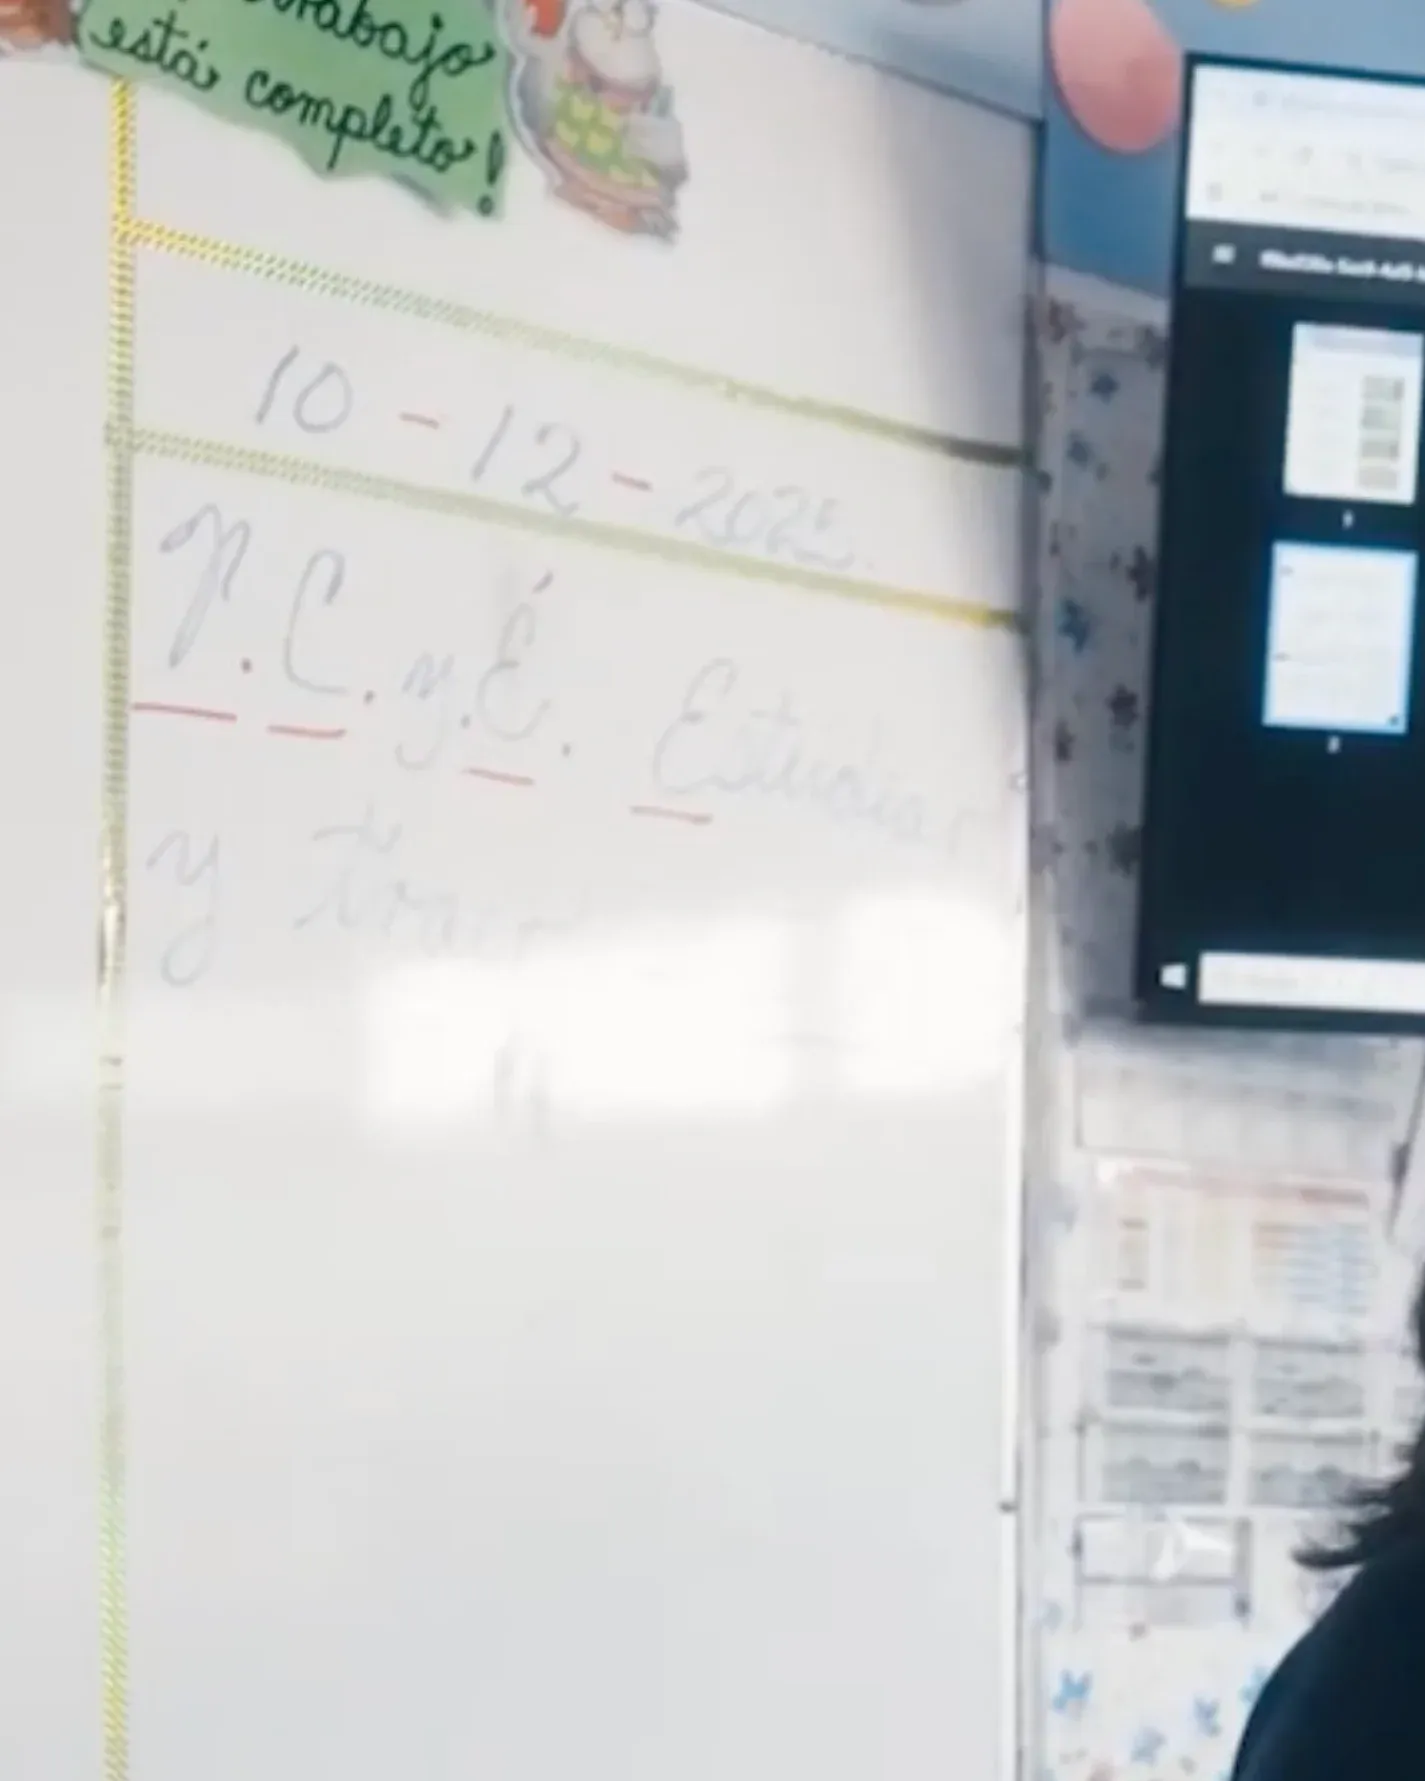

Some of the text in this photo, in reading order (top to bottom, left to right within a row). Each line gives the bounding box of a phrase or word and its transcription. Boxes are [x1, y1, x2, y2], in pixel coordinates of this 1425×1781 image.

[89, 8, 507, 219] está completo!
[243, 0, 497, 112] rabajo
[253, 343, 354, 435] 10
[470, 403, 584, 519] 12
[144, 823, 223, 987] y
